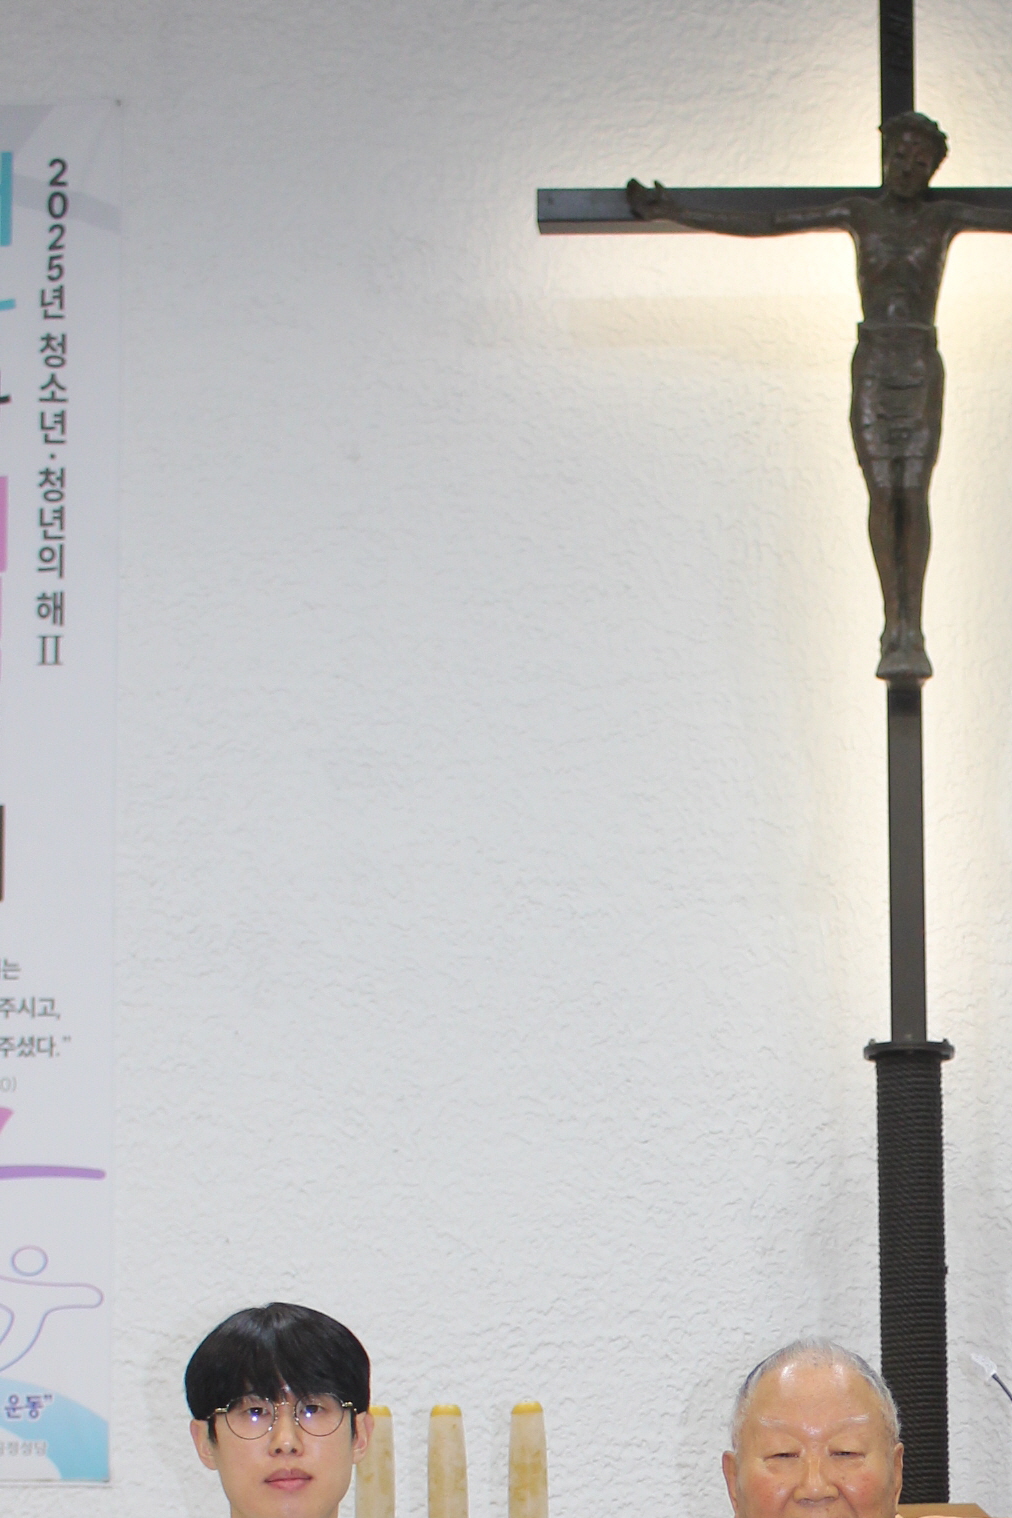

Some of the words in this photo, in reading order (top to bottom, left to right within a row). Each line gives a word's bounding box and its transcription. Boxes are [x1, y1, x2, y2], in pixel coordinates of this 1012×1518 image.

[40, 157, 69, 320] 2025년
[38, 333, 68, 579] 청소년·청년의
[37, 592, 65, 627] 해
